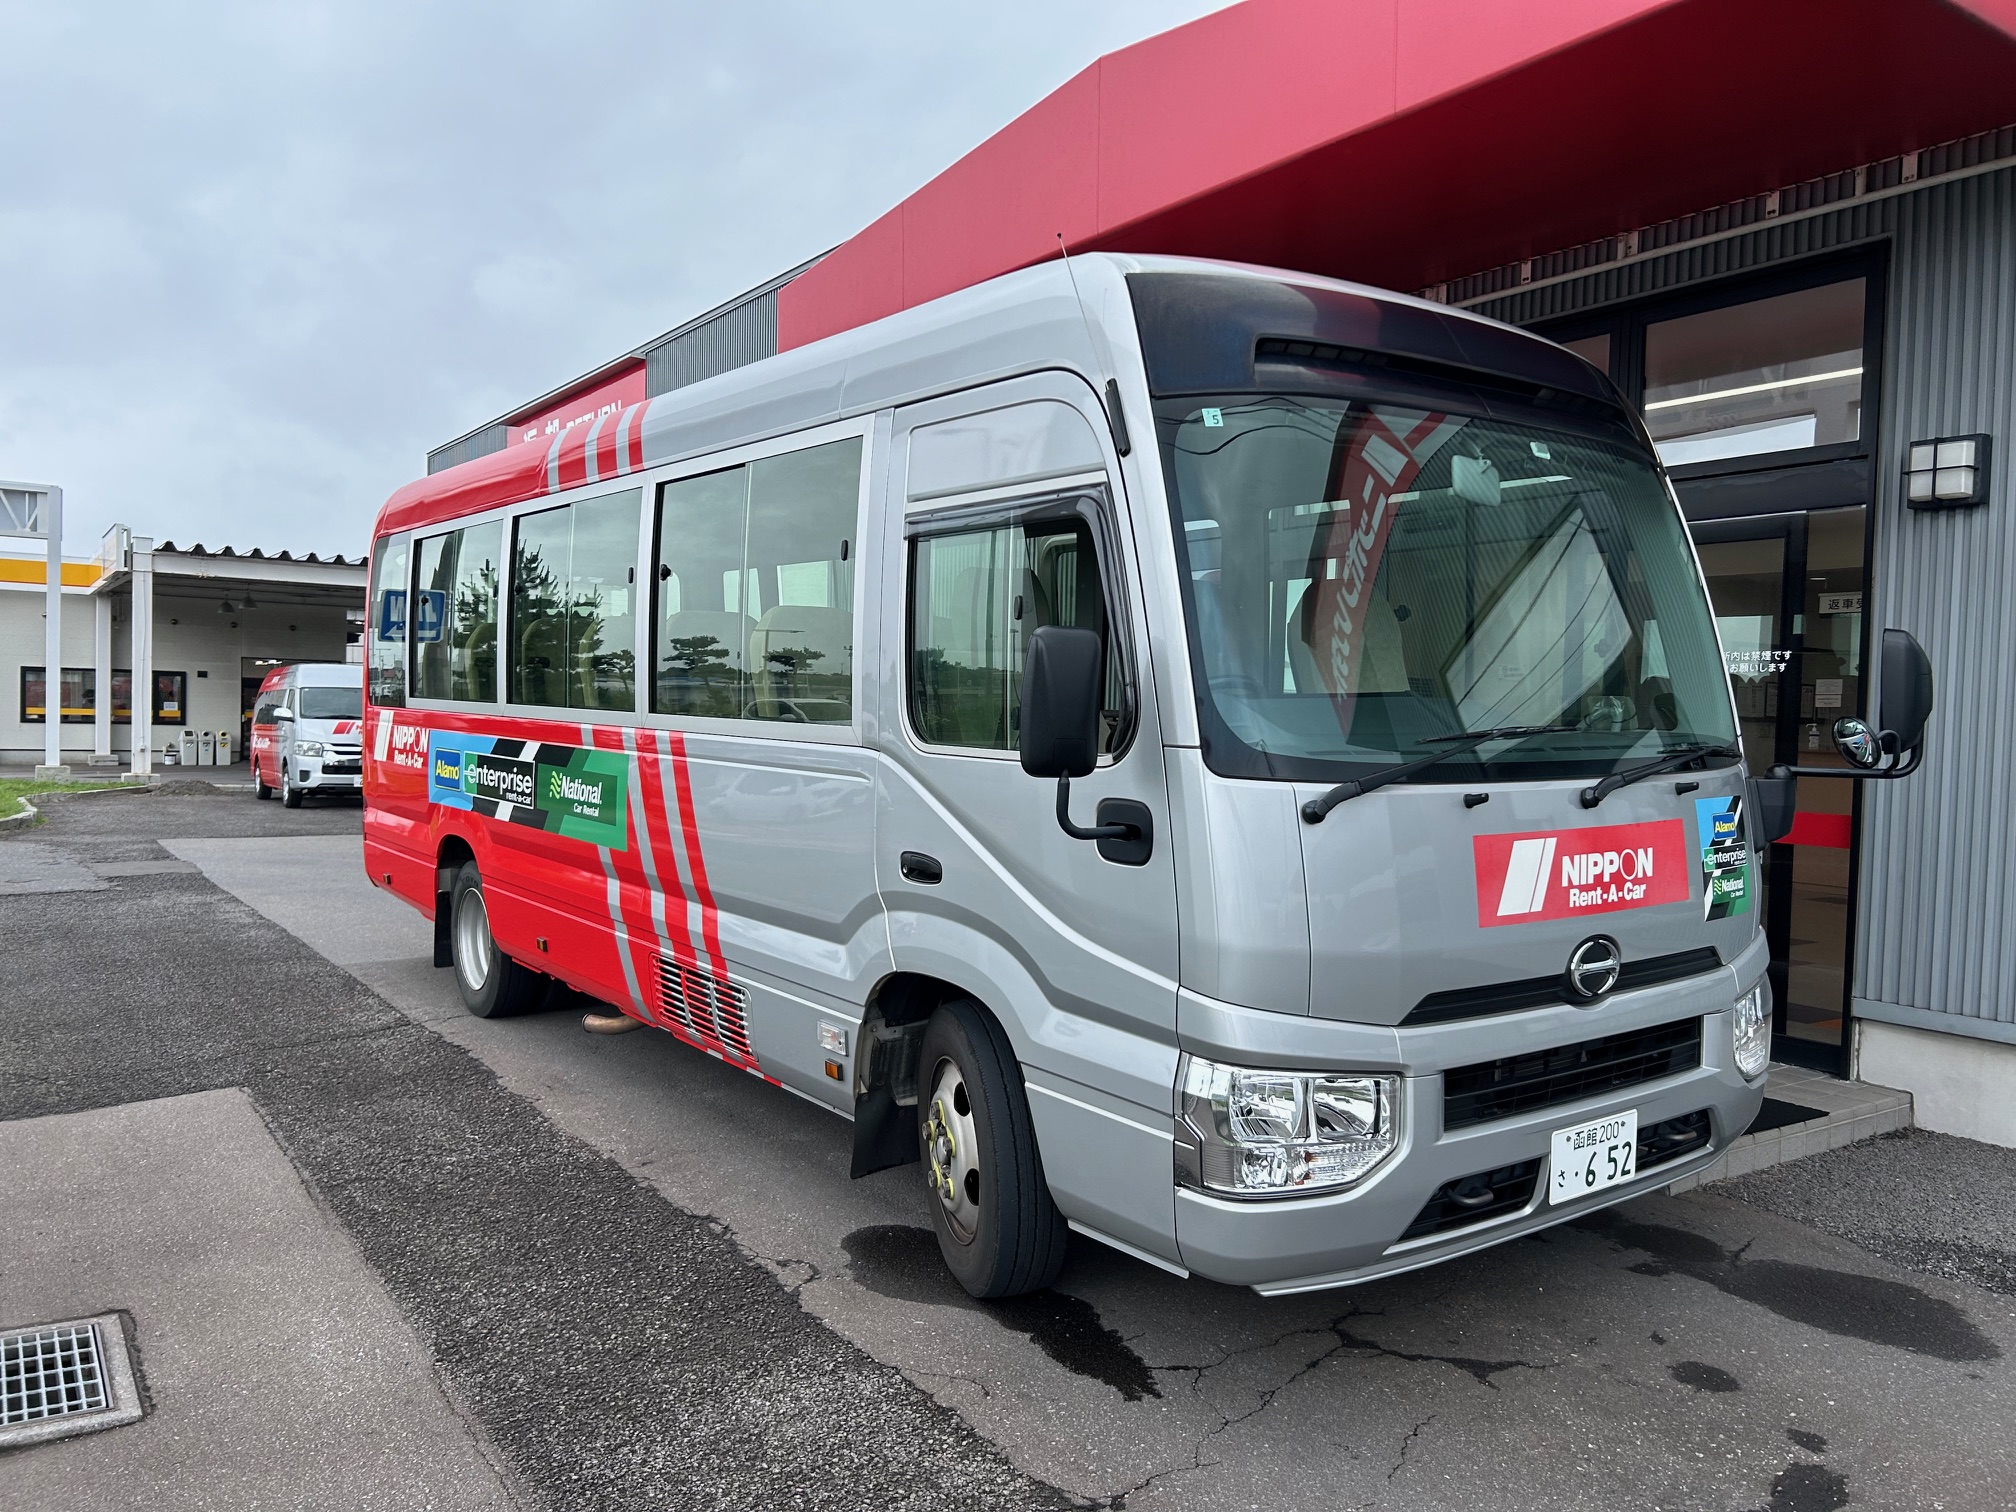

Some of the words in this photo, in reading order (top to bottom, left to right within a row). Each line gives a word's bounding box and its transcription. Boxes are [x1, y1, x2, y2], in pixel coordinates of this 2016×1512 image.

[1212, 414, 1220, 425] 5
[1728, 663, 1788, 673] お願いします
[392, 725, 430, 753] NIPPON
[435, 759, 460, 780] Alamo
[465, 763, 533, 795] enterprise
[505, 791, 532, 805] rent-a-car
[560, 775, 603, 805] National
[573, 803, 582, 813] Car
[583, 804, 600, 818] Rental
[1714, 821, 1735, 834] Alamo
[1705, 848, 1747, 866] enterprise
[1561, 847, 1654, 888] NIPPON
[1722, 876, 1745, 892] National
[1569, 881, 1647, 908] Rent-A-Car
